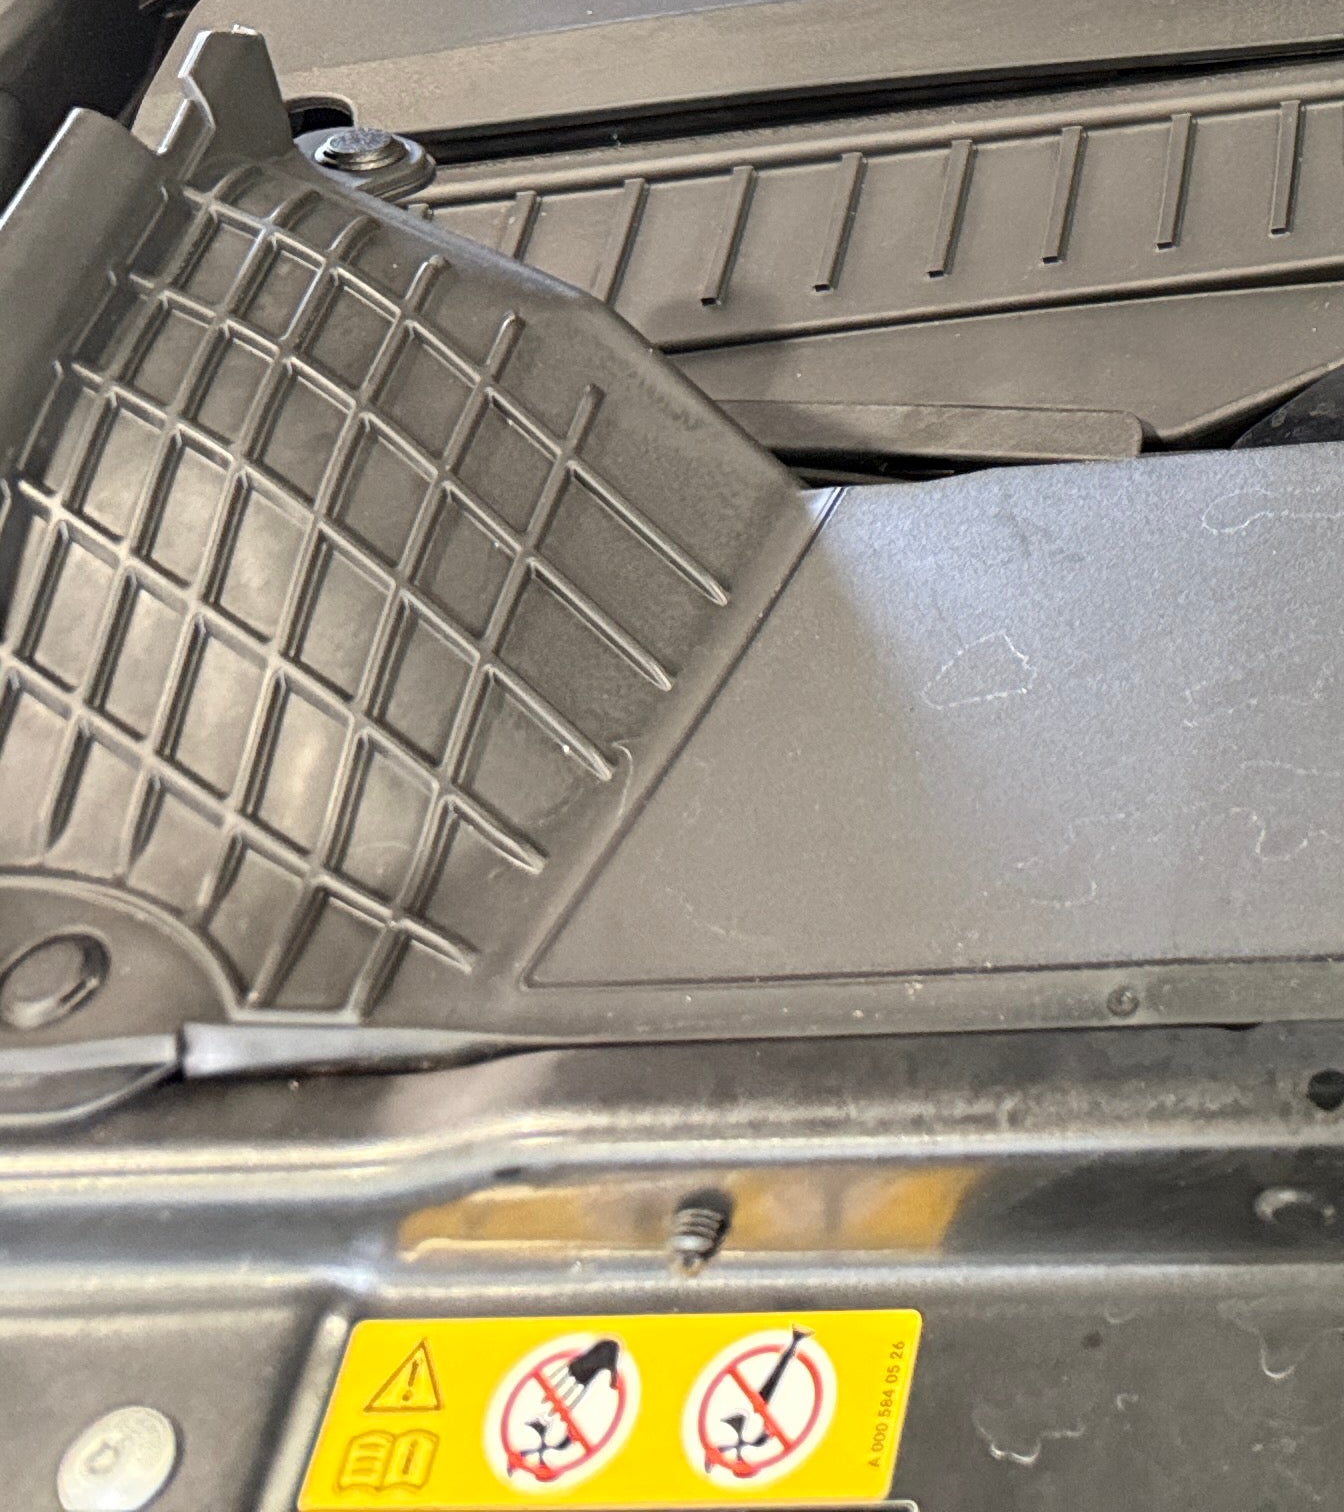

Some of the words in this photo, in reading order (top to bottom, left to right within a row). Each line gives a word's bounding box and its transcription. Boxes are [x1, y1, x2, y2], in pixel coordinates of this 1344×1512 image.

[889, 1341, 905, 1360] 26
[885, 1364, 900, 1384] 05
[878, 1389, 895, 1417] 584
[871, 1422, 889, 1452] 000
[868, 1457, 881, 1468] A
